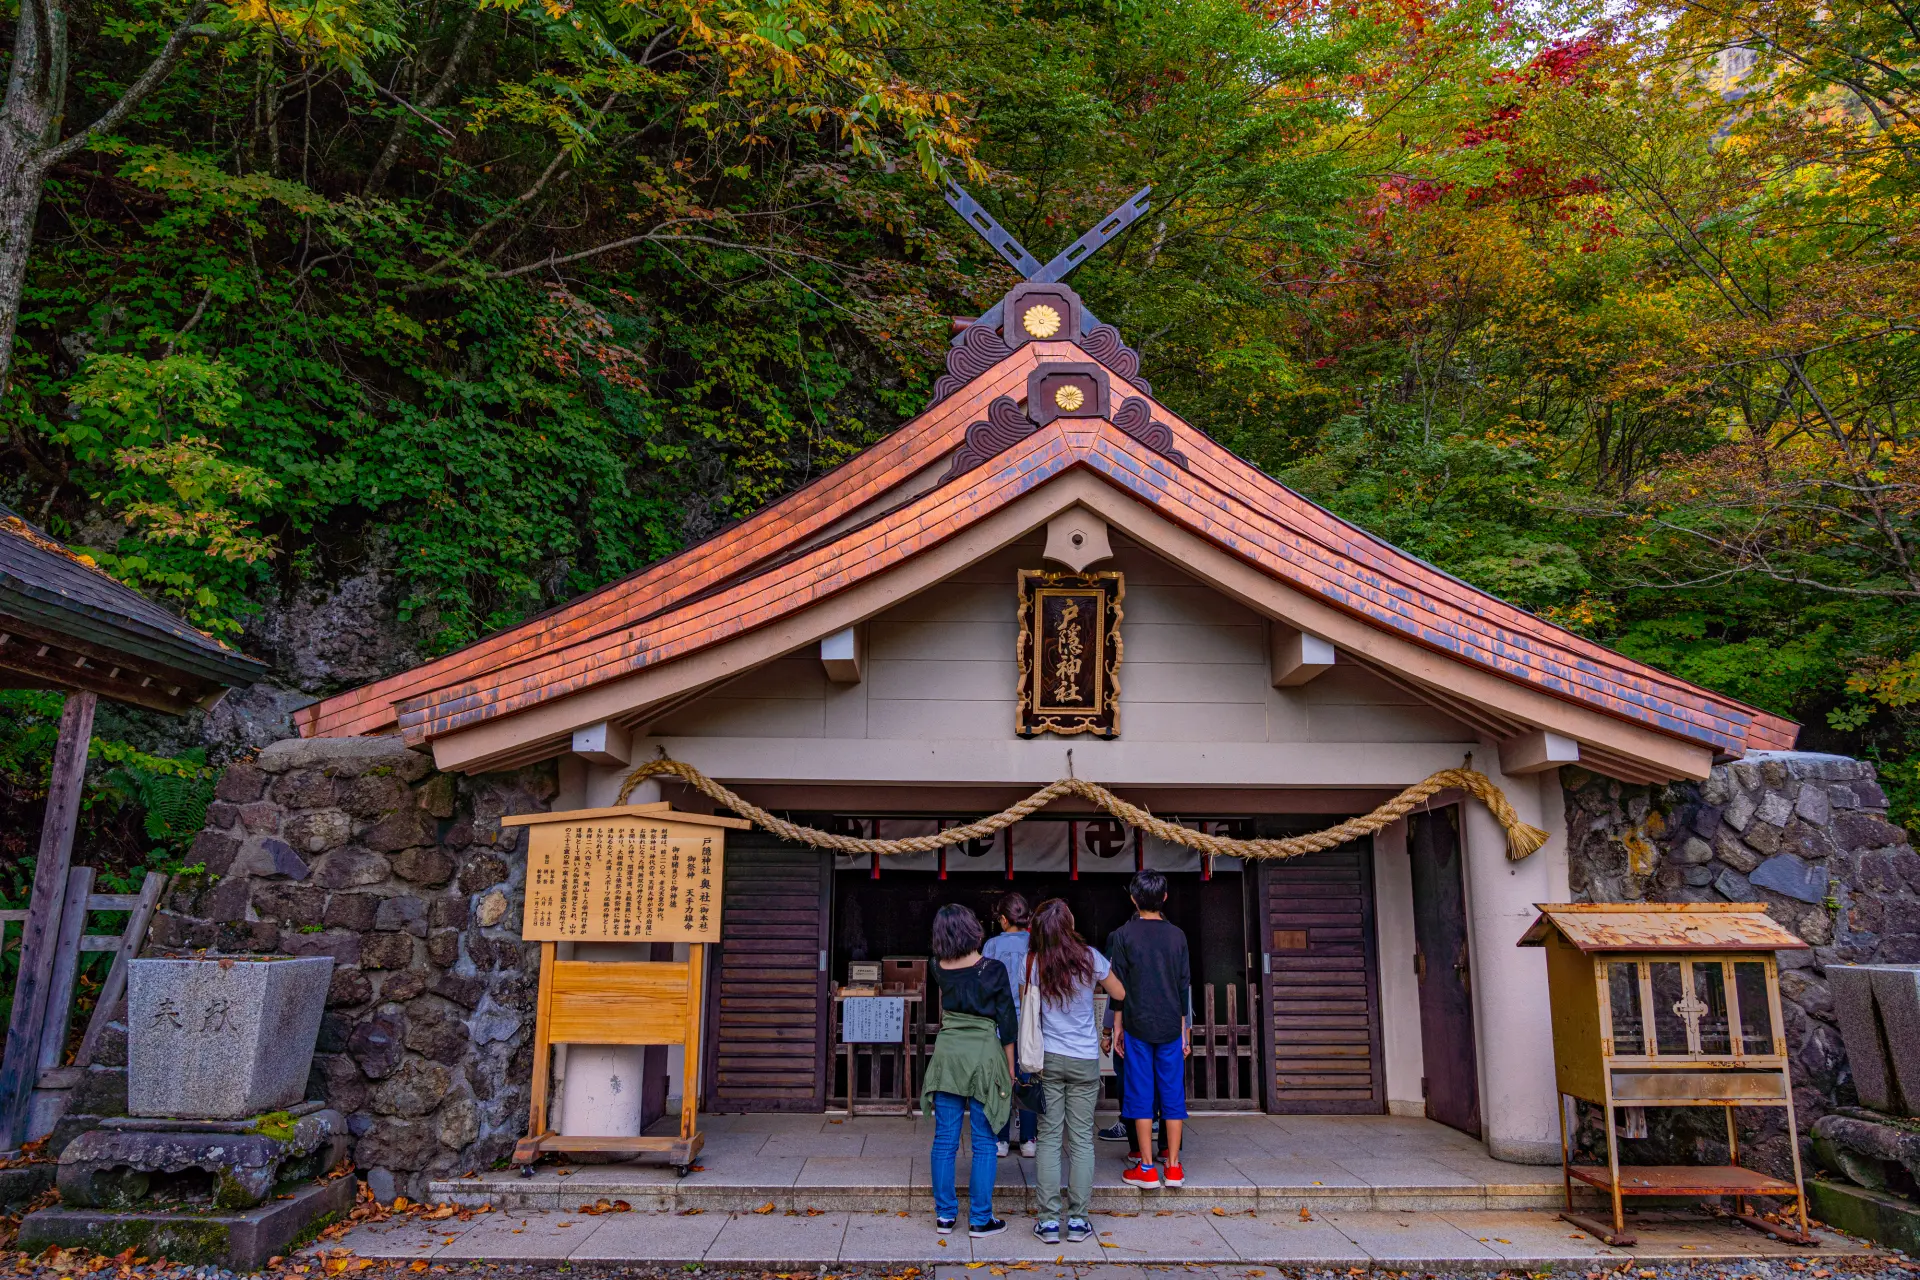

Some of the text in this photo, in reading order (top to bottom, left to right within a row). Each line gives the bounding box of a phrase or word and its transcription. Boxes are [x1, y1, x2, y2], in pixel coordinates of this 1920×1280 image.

[684, 855, 696, 930] 御祭神 天手力雄命
